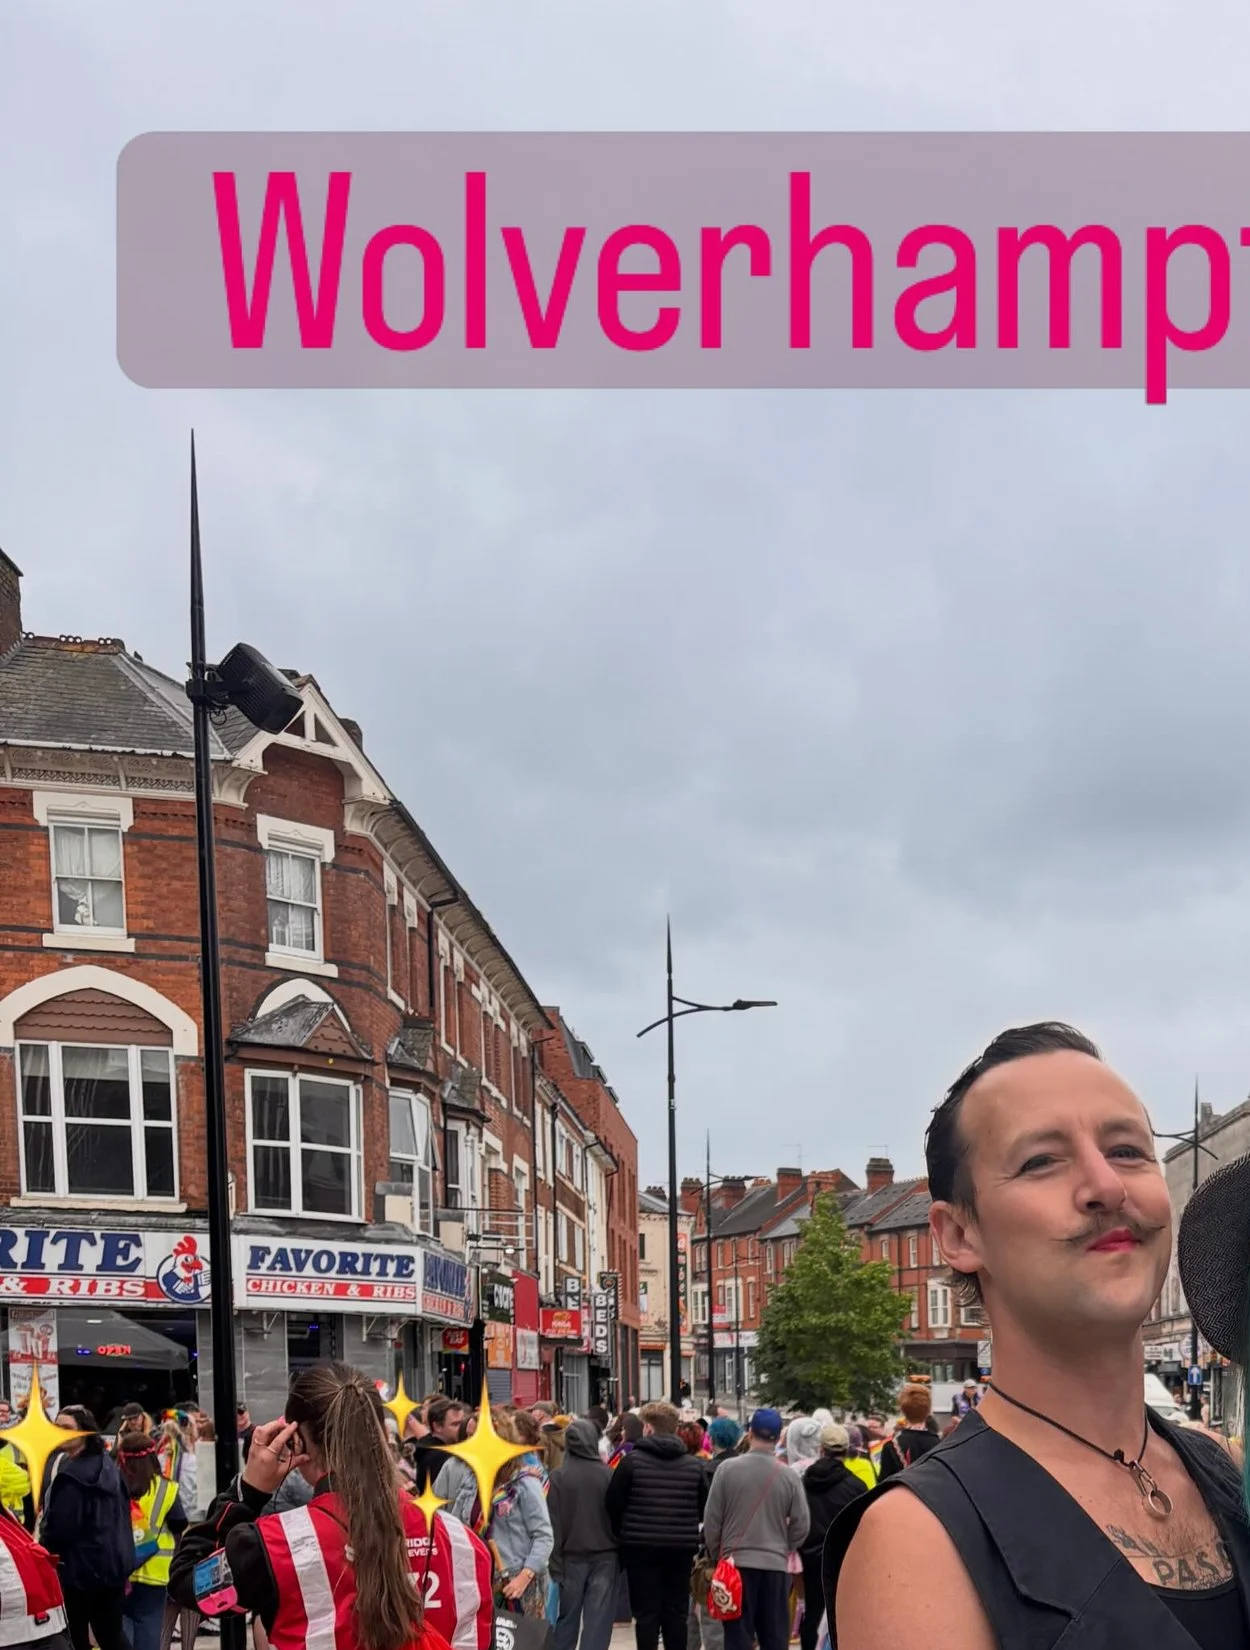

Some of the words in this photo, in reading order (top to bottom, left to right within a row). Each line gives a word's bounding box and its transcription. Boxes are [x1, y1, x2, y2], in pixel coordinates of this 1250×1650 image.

[247, 1245, 415, 1278] FAVORITE
[2, 1277, 28, 1294] &
[46, 1278, 145, 1297] RIBS
[247, 1279, 335, 1296] CHICKEN
[347, 1285, 361, 1297] &
[372, 1285, 416, 1299] RIBS
[595, 1294, 608, 1354] BEDS
[97, 1345, 131, 1356] OPEN
